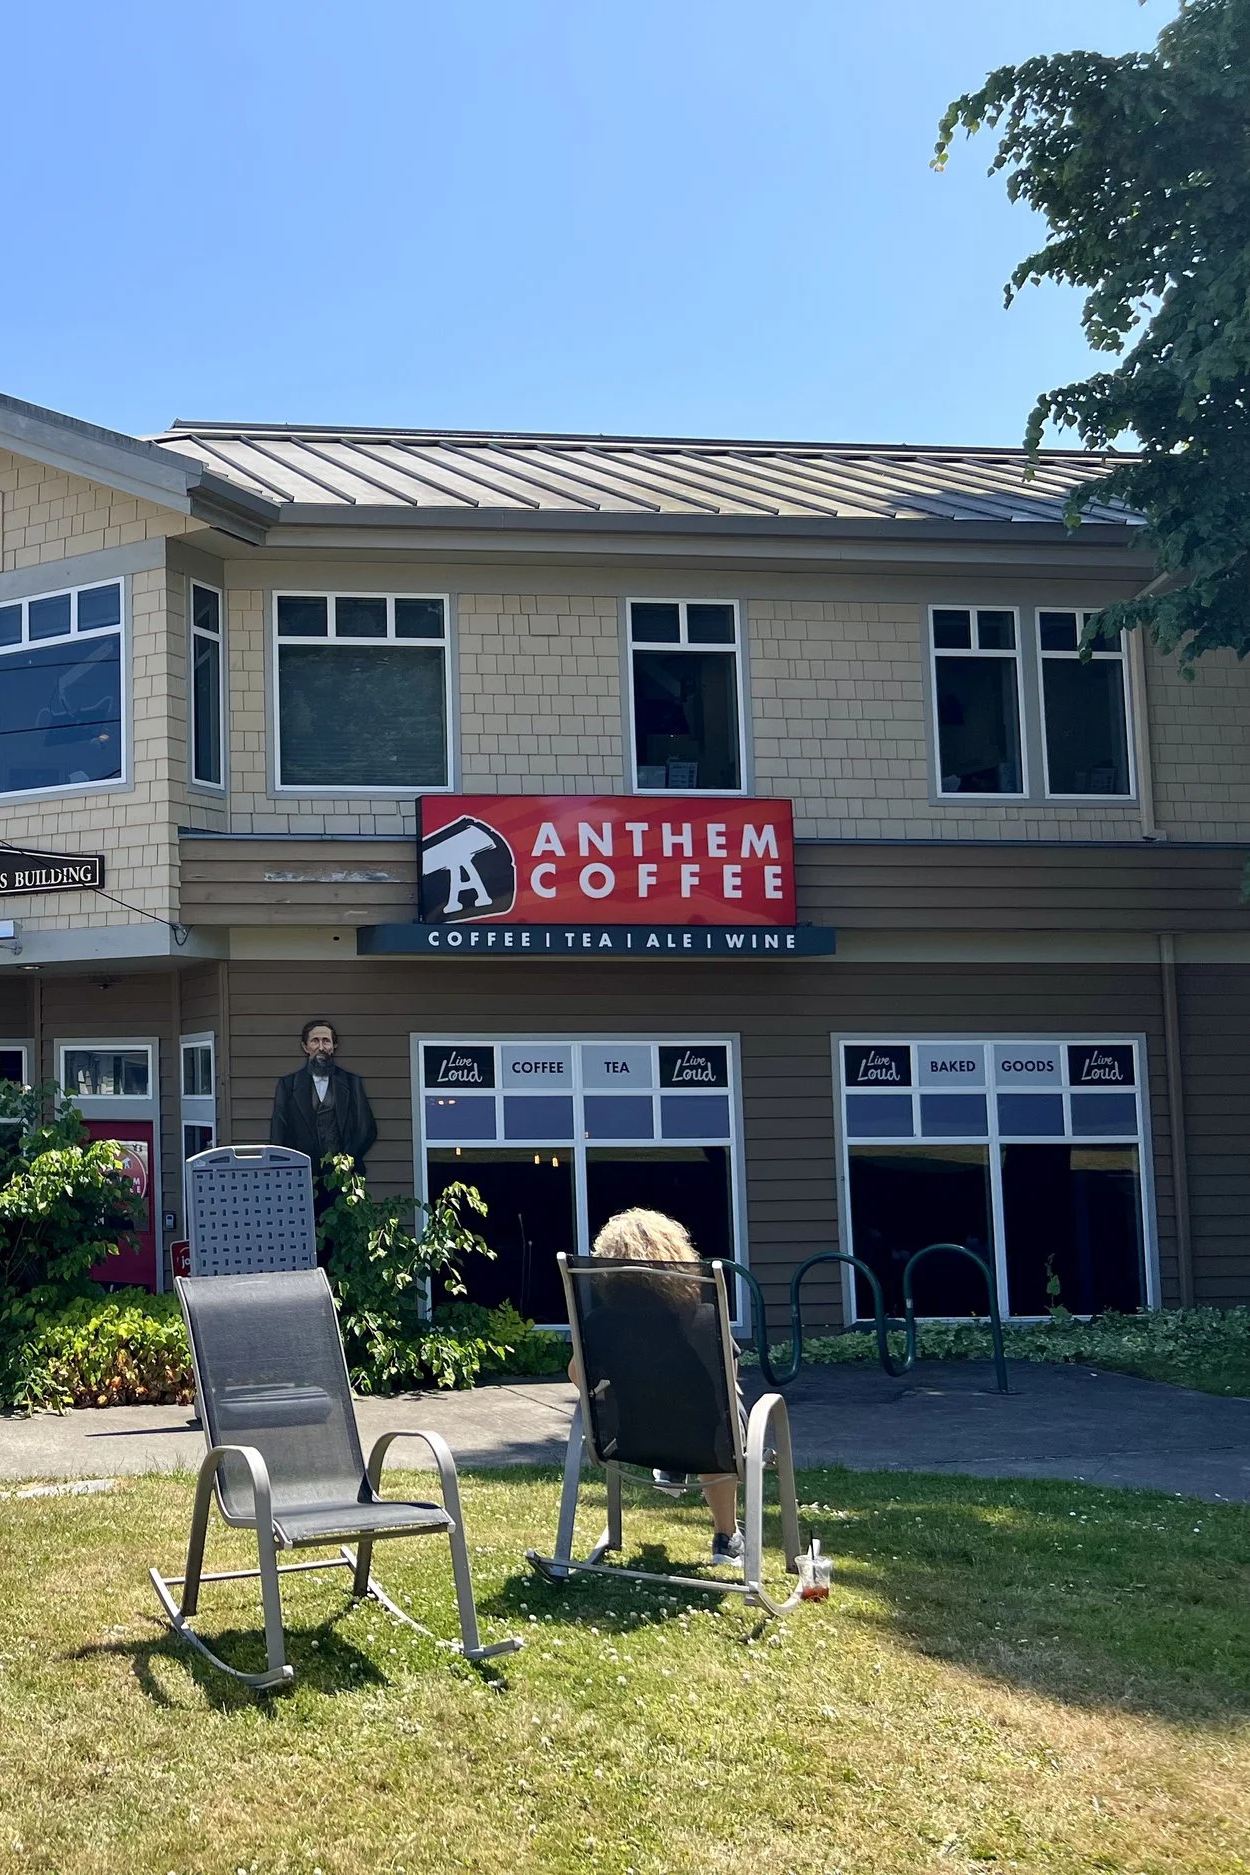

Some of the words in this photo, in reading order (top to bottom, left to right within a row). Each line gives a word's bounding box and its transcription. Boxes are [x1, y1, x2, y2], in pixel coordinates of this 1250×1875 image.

[530, 821, 780, 859] ANTHEM
[14, 864, 92, 889] BUILDING
[530, 862, 784, 900] COFFEE
[428, 931, 531, 948] COFFEE
[565, 932, 613, 949] TEA
[646, 933, 693, 949] ALE
[726, 933, 796, 951] WINE
[448, 1051, 472, 1068] Live
[682, 1050, 706, 1067] Live
[867, 1050, 890, 1067] Live
[930, 1061, 976, 1072] BAKED
[1001, 1060, 1054, 1072] GOODS
[1090, 1050, 1113, 1066] Live
[437, 1060, 483, 1083] Loud
[512, 1062, 564, 1074] COFFEE
[604, 1062, 630, 1073] TEA
[671, 1059, 717, 1082] Loud
[857, 1059, 900, 1081] Loud
[1081, 1059, 1123, 1081] Loud
